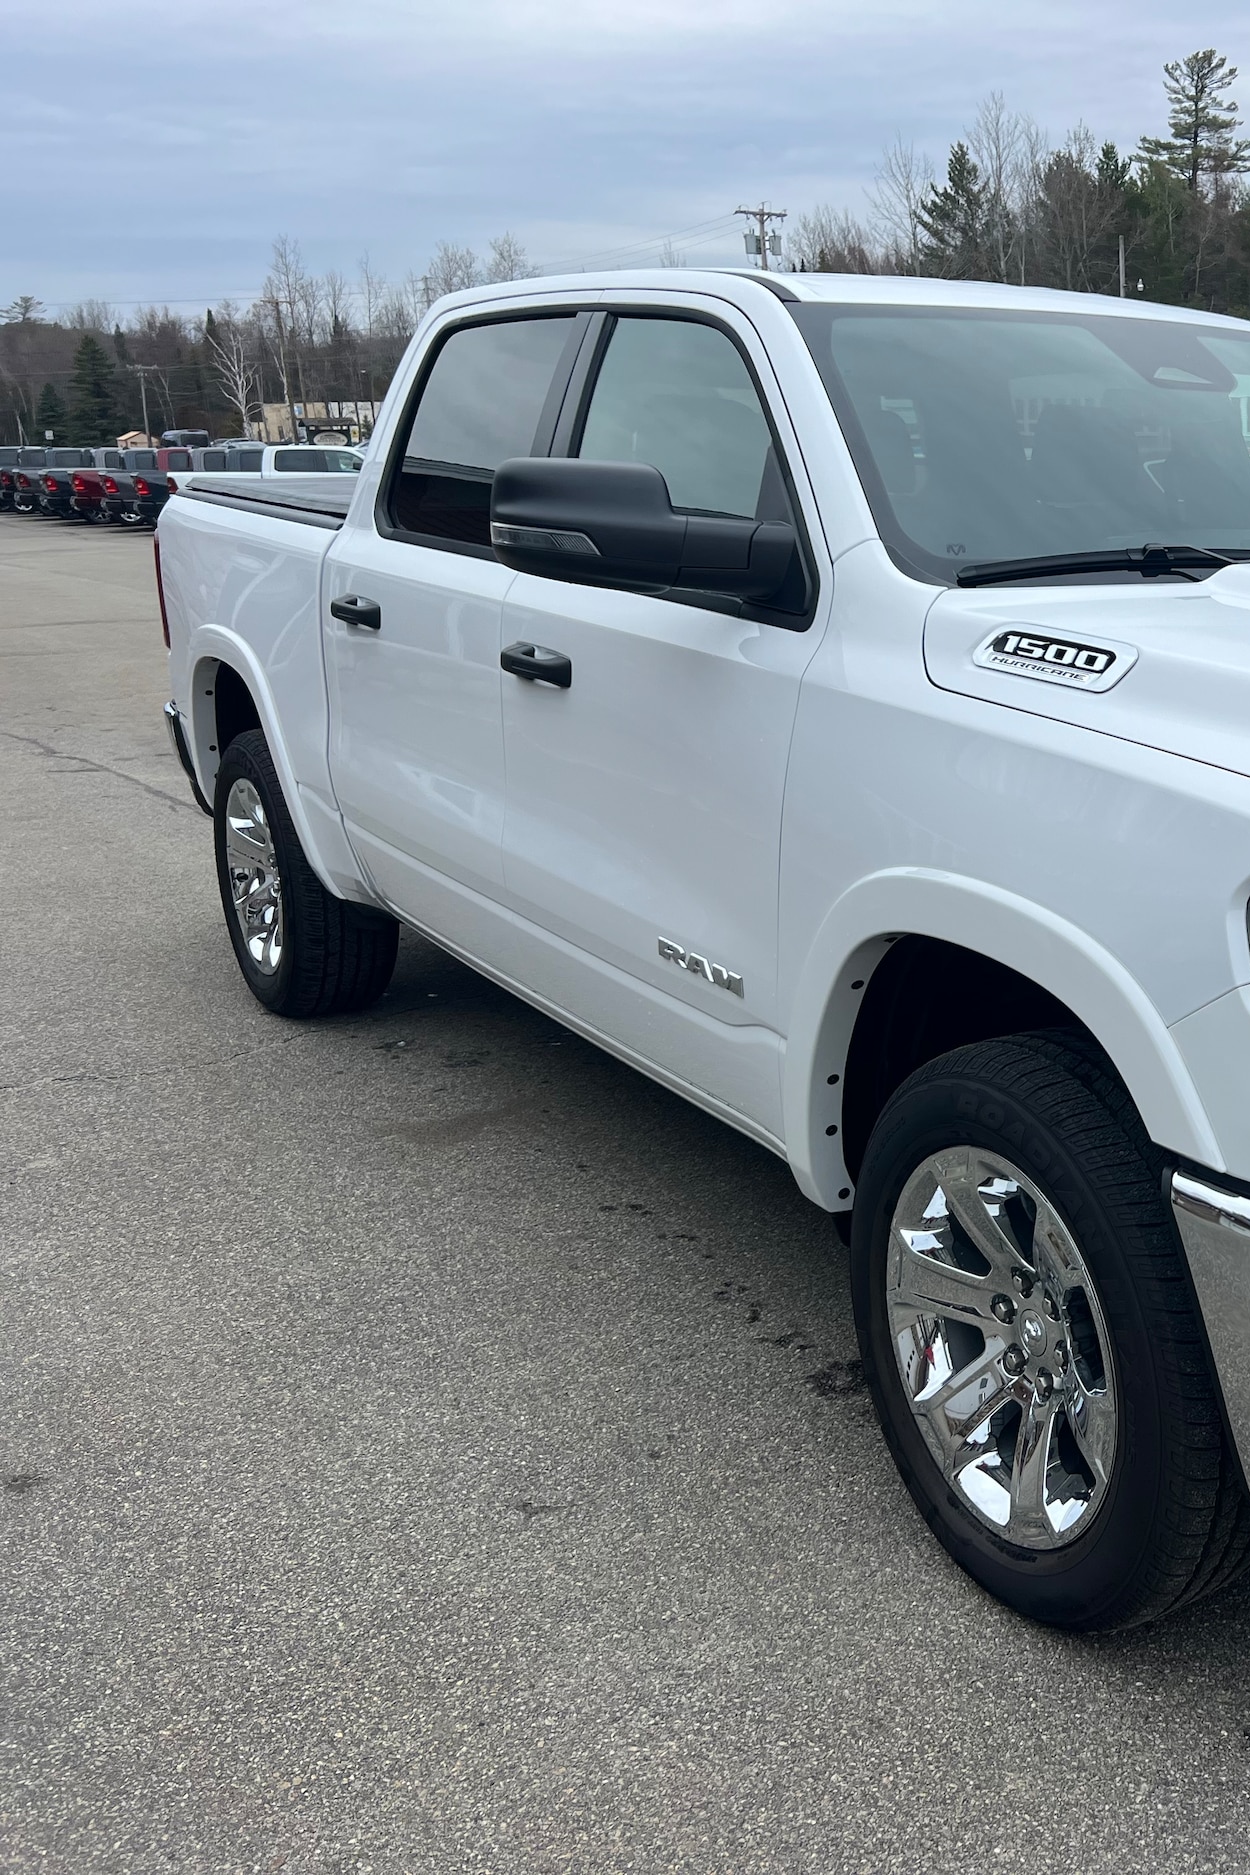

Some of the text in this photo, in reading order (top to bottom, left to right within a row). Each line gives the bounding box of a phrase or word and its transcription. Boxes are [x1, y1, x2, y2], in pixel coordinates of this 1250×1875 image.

[991, 656, 1088, 680] HURRICANE
[1003, 635, 1110, 671] 1500
[657, 936, 744, 999] RAM
[954, 1091, 1109, 1256] ROADIAN
